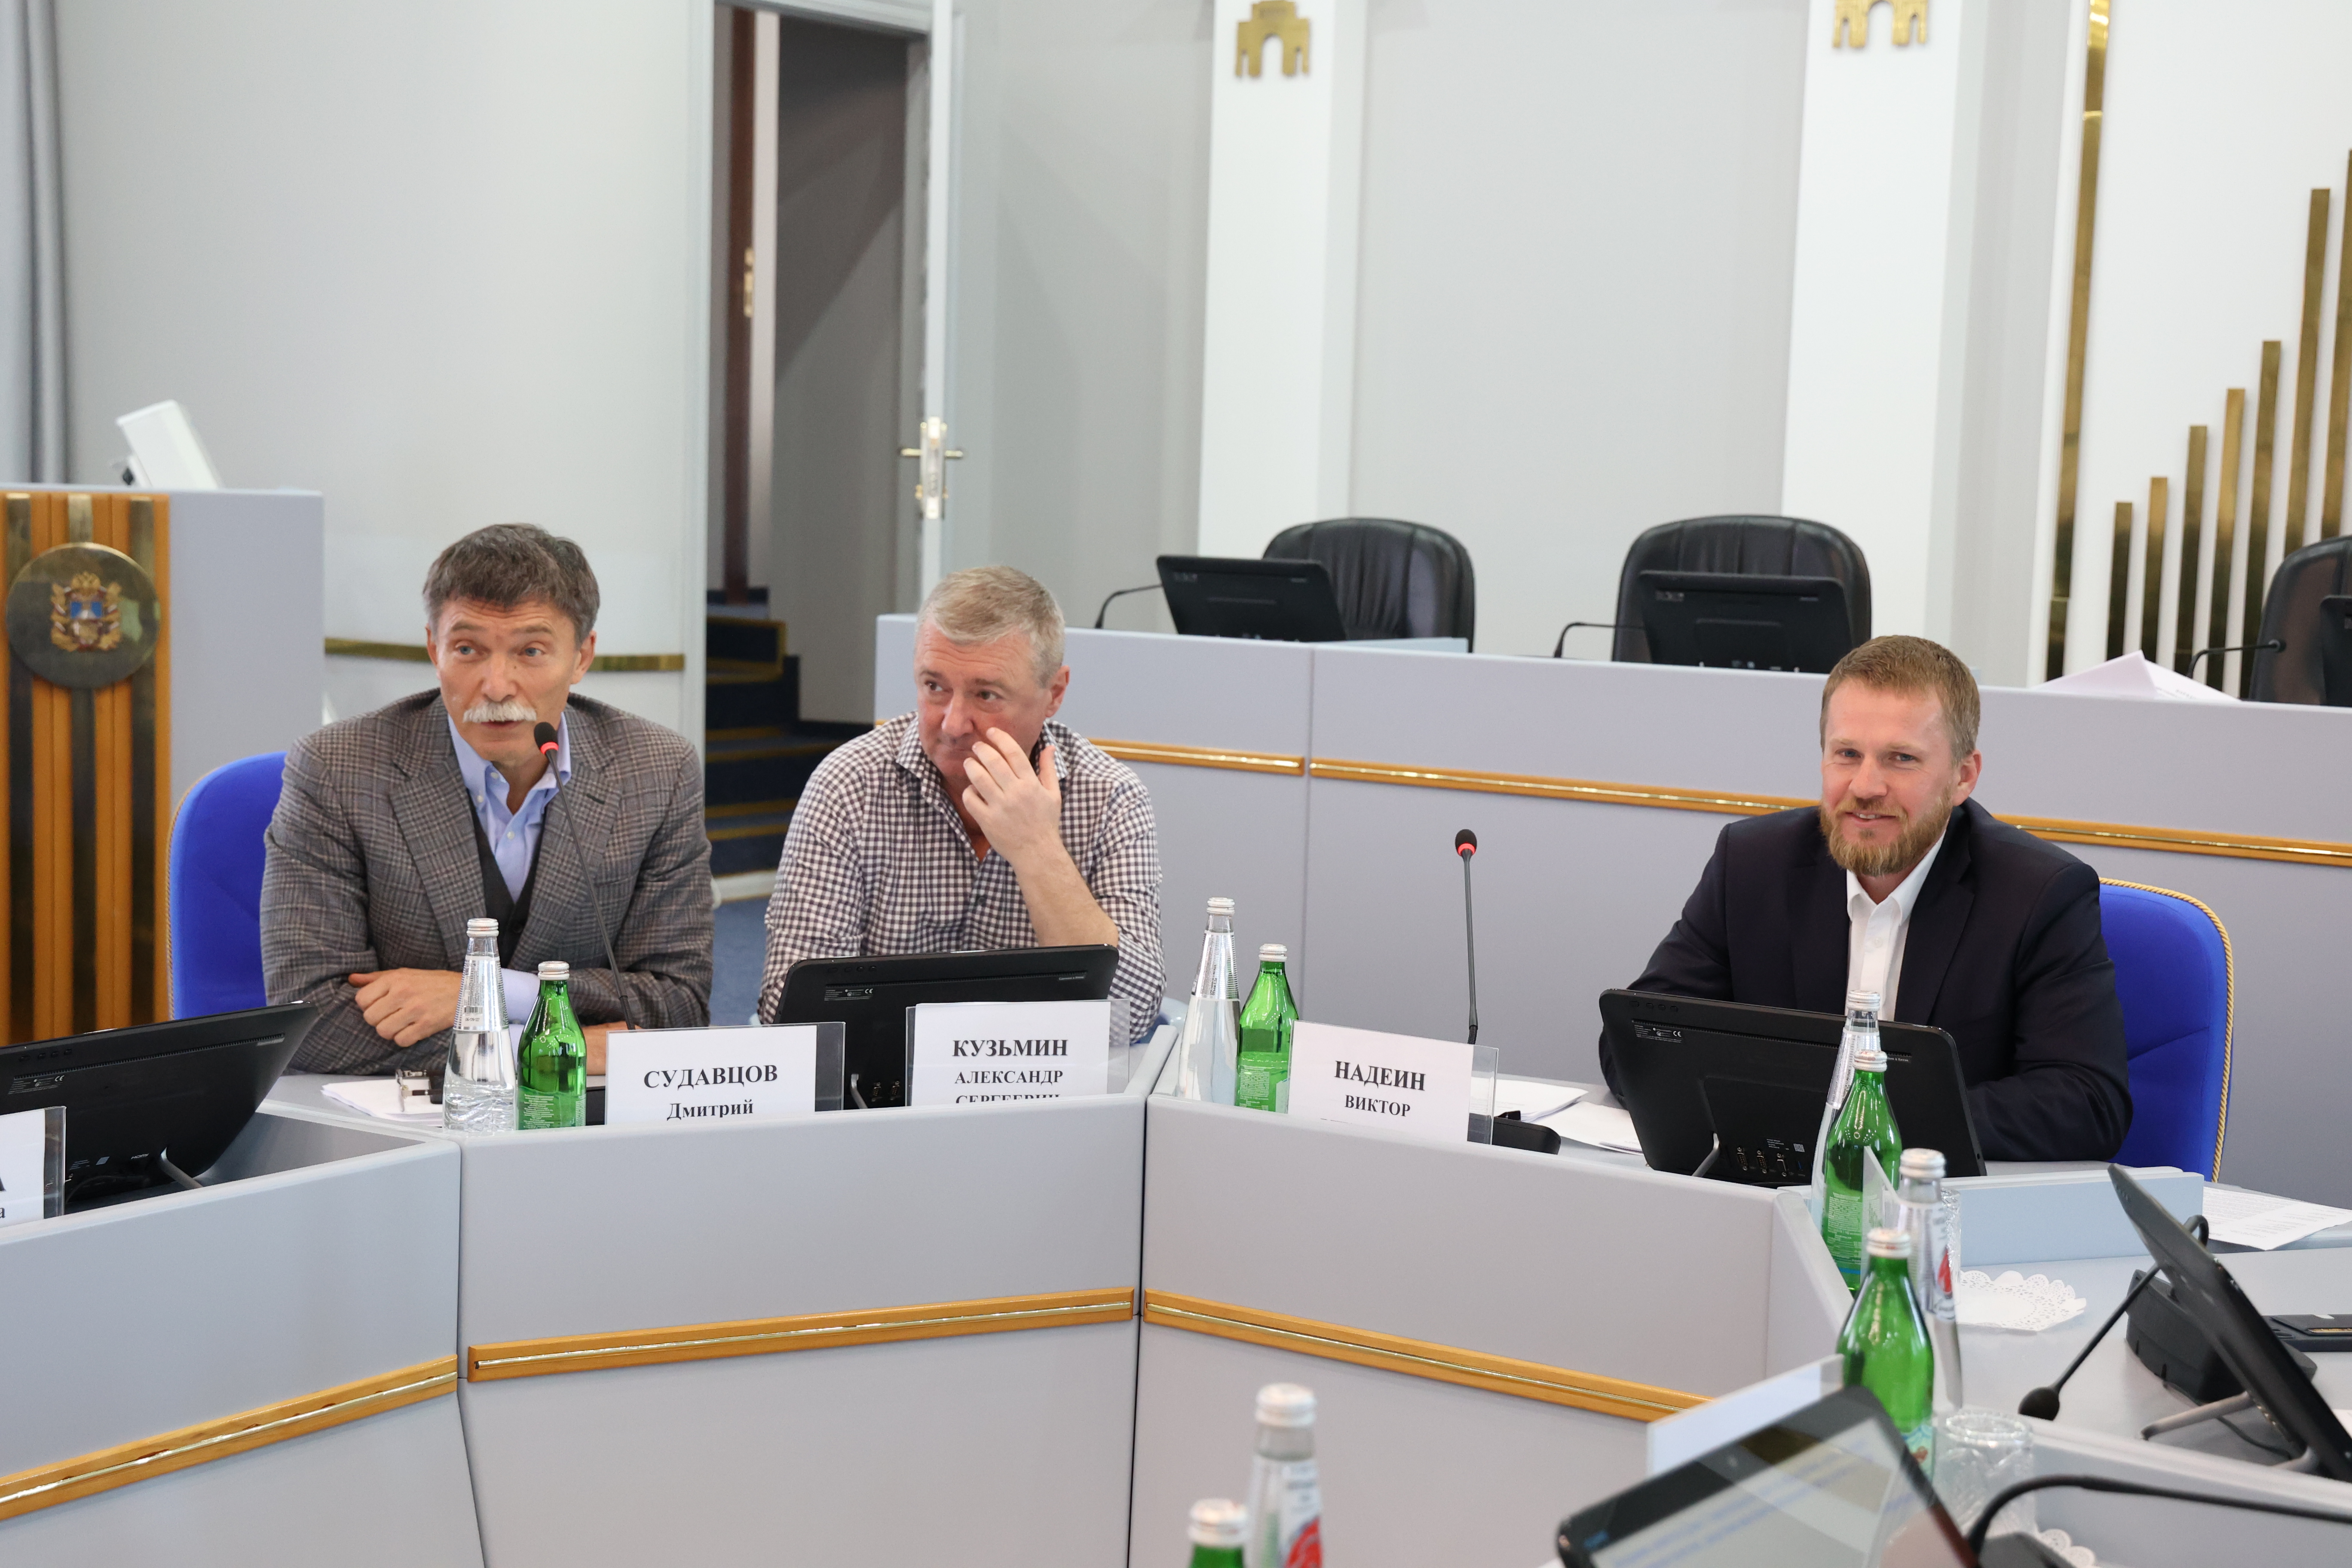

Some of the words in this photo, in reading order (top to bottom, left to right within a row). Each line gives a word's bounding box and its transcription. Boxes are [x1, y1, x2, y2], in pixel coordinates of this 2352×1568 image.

[952, 1039, 1068, 1057] КУЗЬМИН
[644, 1065, 778, 1091] СУДАВЦОВ
[954, 1070, 1063, 1086] АЛЕКСАНДР
[1334, 1060, 1426, 1091] НАДЕИН
[667, 1099, 753, 1121] Дмитрий
[1344, 1094, 1411, 1117] ВИКТОР
